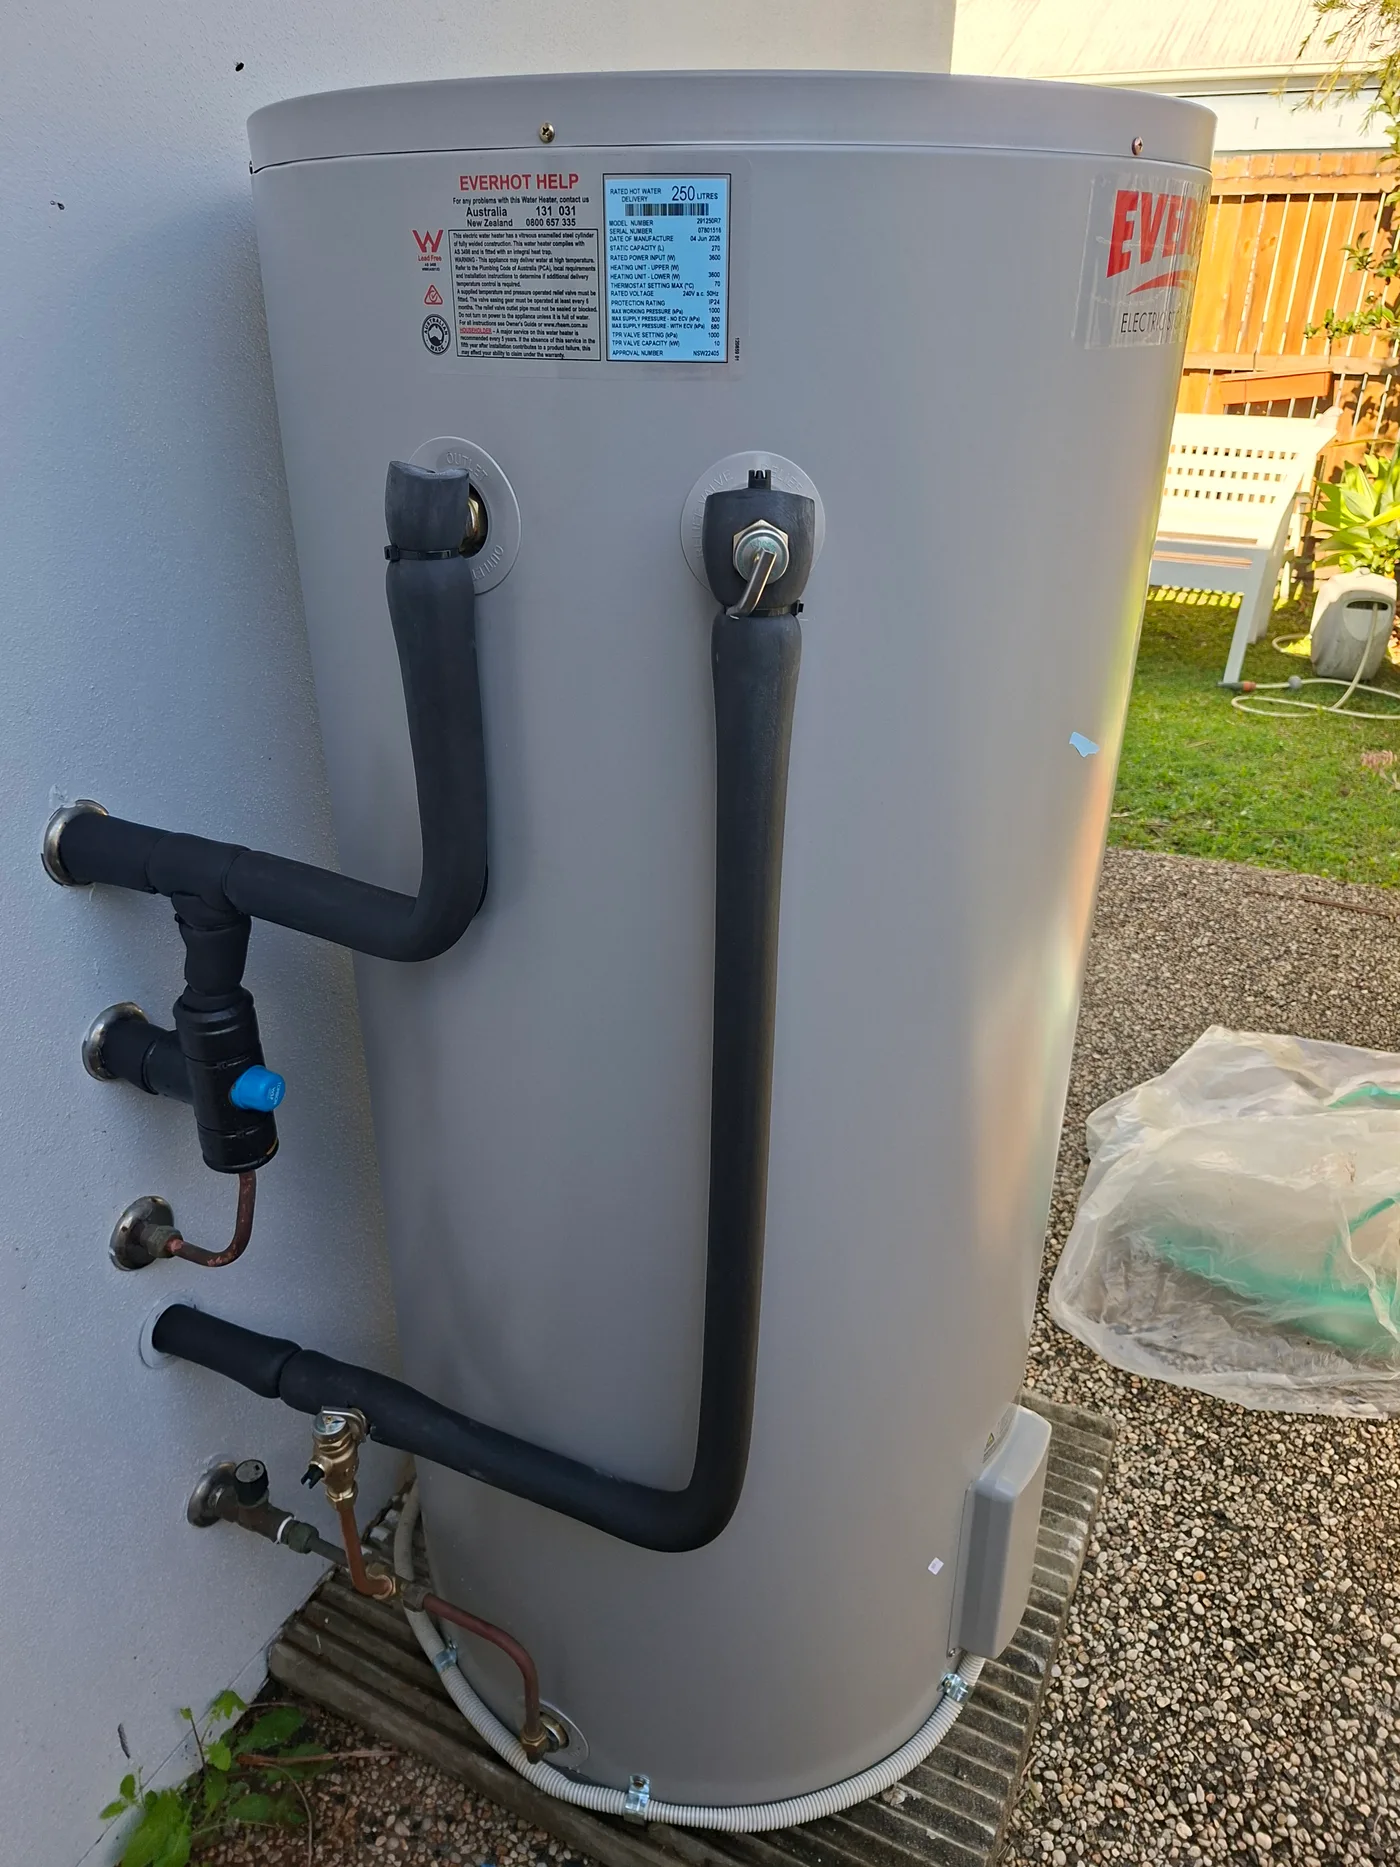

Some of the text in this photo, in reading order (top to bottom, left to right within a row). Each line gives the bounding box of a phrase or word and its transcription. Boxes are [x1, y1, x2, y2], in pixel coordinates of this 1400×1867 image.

[460, 174, 579, 190] EVERHOT HELP
[672, 186, 695, 201] 250
[539, 196, 558, 204] Heater,
[466, 206, 576, 217] Australia 131 031
[467, 218, 576, 227] New Zealand 0800 657 335
[671, 264, 679, 272] (W)
[447, 452, 488, 481] OUTLET
